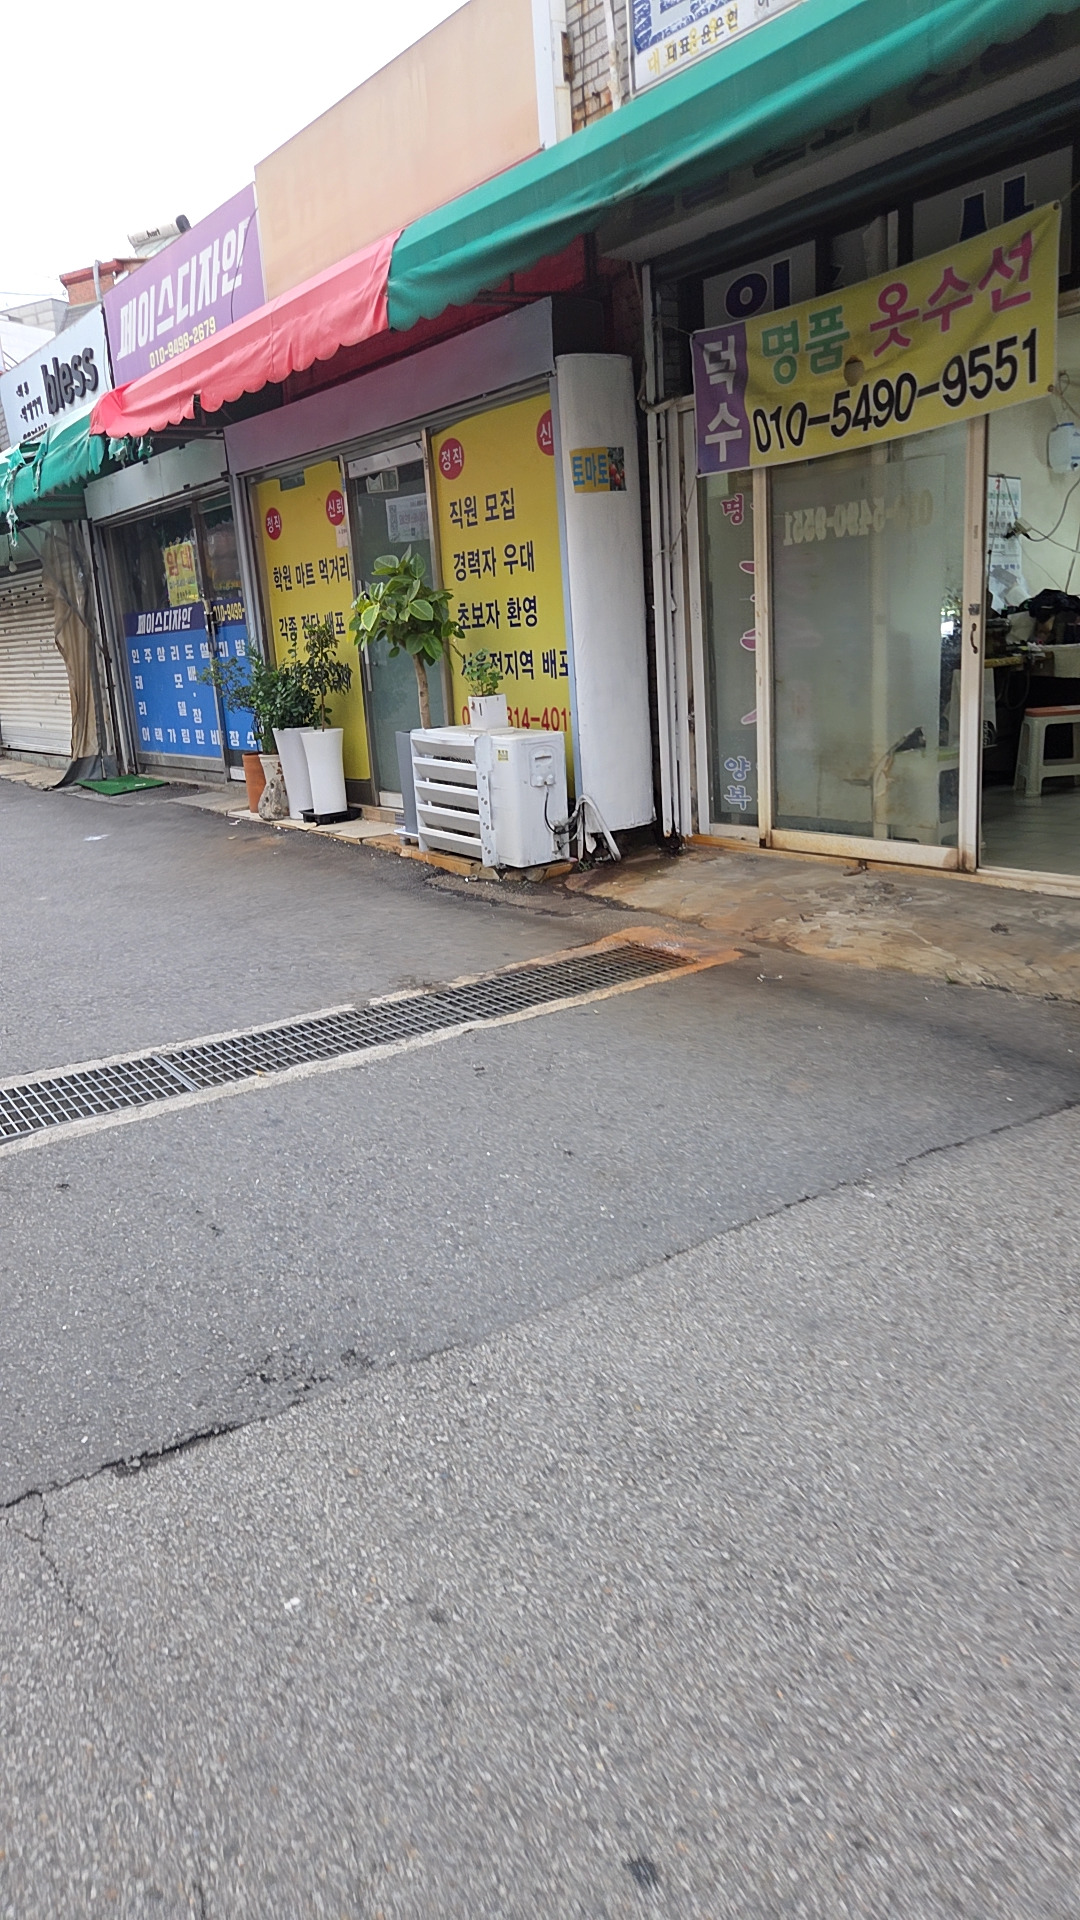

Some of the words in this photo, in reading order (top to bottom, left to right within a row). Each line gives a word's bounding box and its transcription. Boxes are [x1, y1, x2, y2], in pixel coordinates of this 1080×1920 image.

[116, 216, 251, 361] 페이스디자인
[761, 304, 850, 385] 명품
[869, 229, 1034, 358] 옷수선
[149, 316, 216, 369] 010-9498-2679
[41, 347, 99, 415] bless
[703, 334, 743, 463] 덕수
[752, 328, 1038, 453] 010-5490-9551
[441, 444, 463, 471] 정직
[573, 453, 608, 488] 토마토
[266, 514, 281, 534] 정직
[328, 497, 344, 518] 신뢰
[449, 495, 478, 529] 직원
[484, 487, 516, 522] 모집
[273, 565, 293, 592] 학원
[295, 562, 316, 588] 마트
[318, 553, 351, 585] 먹거리
[453, 546, 497, 582] 경력자
[503, 540, 535, 575] 우대
[136, 606, 193, 635] 페이스디자인
[278, 616, 298, 642] 각종
[457, 599, 500, 631] 초보자
[506, 595, 538, 628] 환영
[723, 756, 752, 811] 양복
